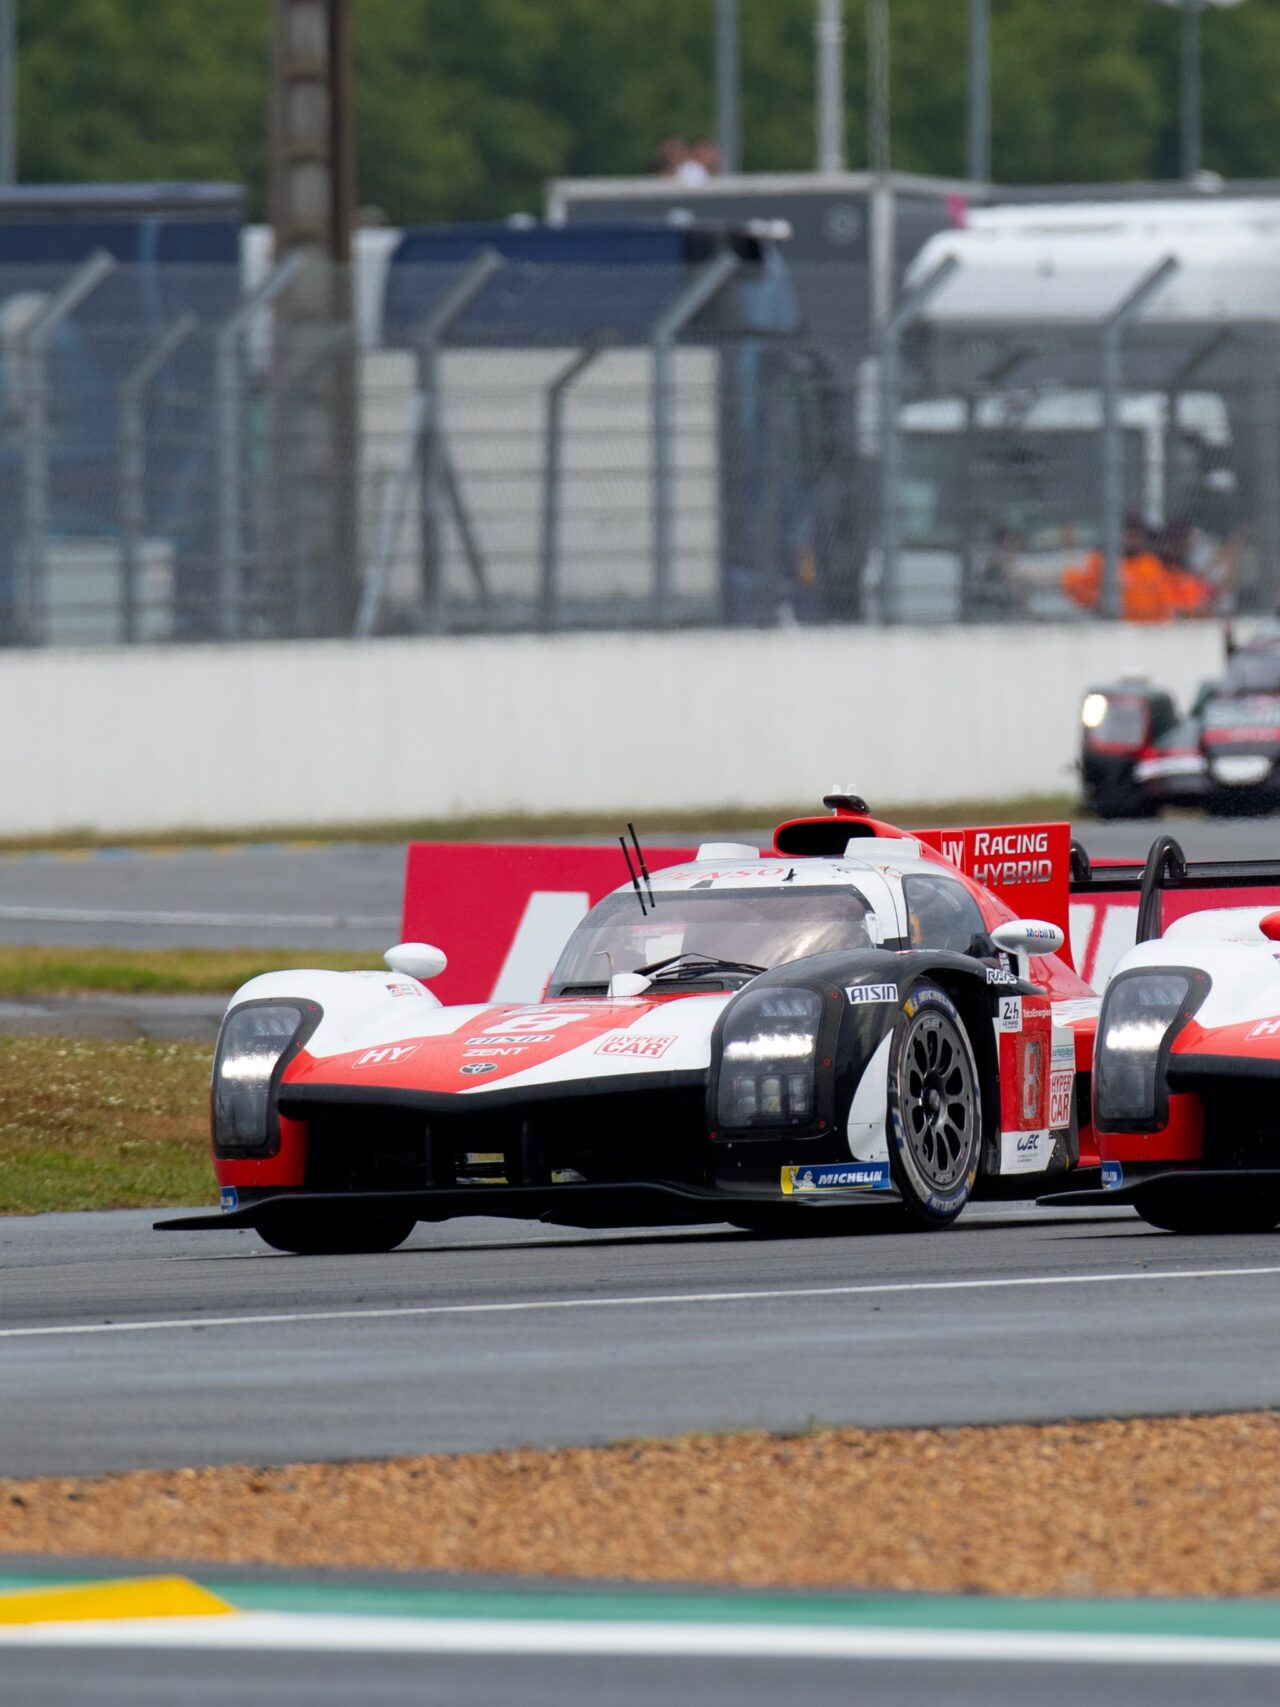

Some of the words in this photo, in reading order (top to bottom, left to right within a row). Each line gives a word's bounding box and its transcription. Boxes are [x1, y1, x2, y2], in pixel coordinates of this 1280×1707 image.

[973, 859, 1052, 886] HYBRID
[1025, 928, 1048, 938] Mobil
[851, 985, 896, 1002] AISIN
[482, 1013, 590, 1034] 8
[602, 1043, 661, 1055] CAR
[610, 1037, 671, 1045] HYPER
[358, 1046, 416, 1064] HY
[462, 1047, 528, 1057] ZENT
[1023, 1041, 1041, 1120] 8
[1051, 1075, 1072, 1094] HYPER
[1050, 1094, 1070, 1122] CAR
[1017, 1134, 1039, 1151] WEC
[818, 1170, 883, 1184] MICHELIN
